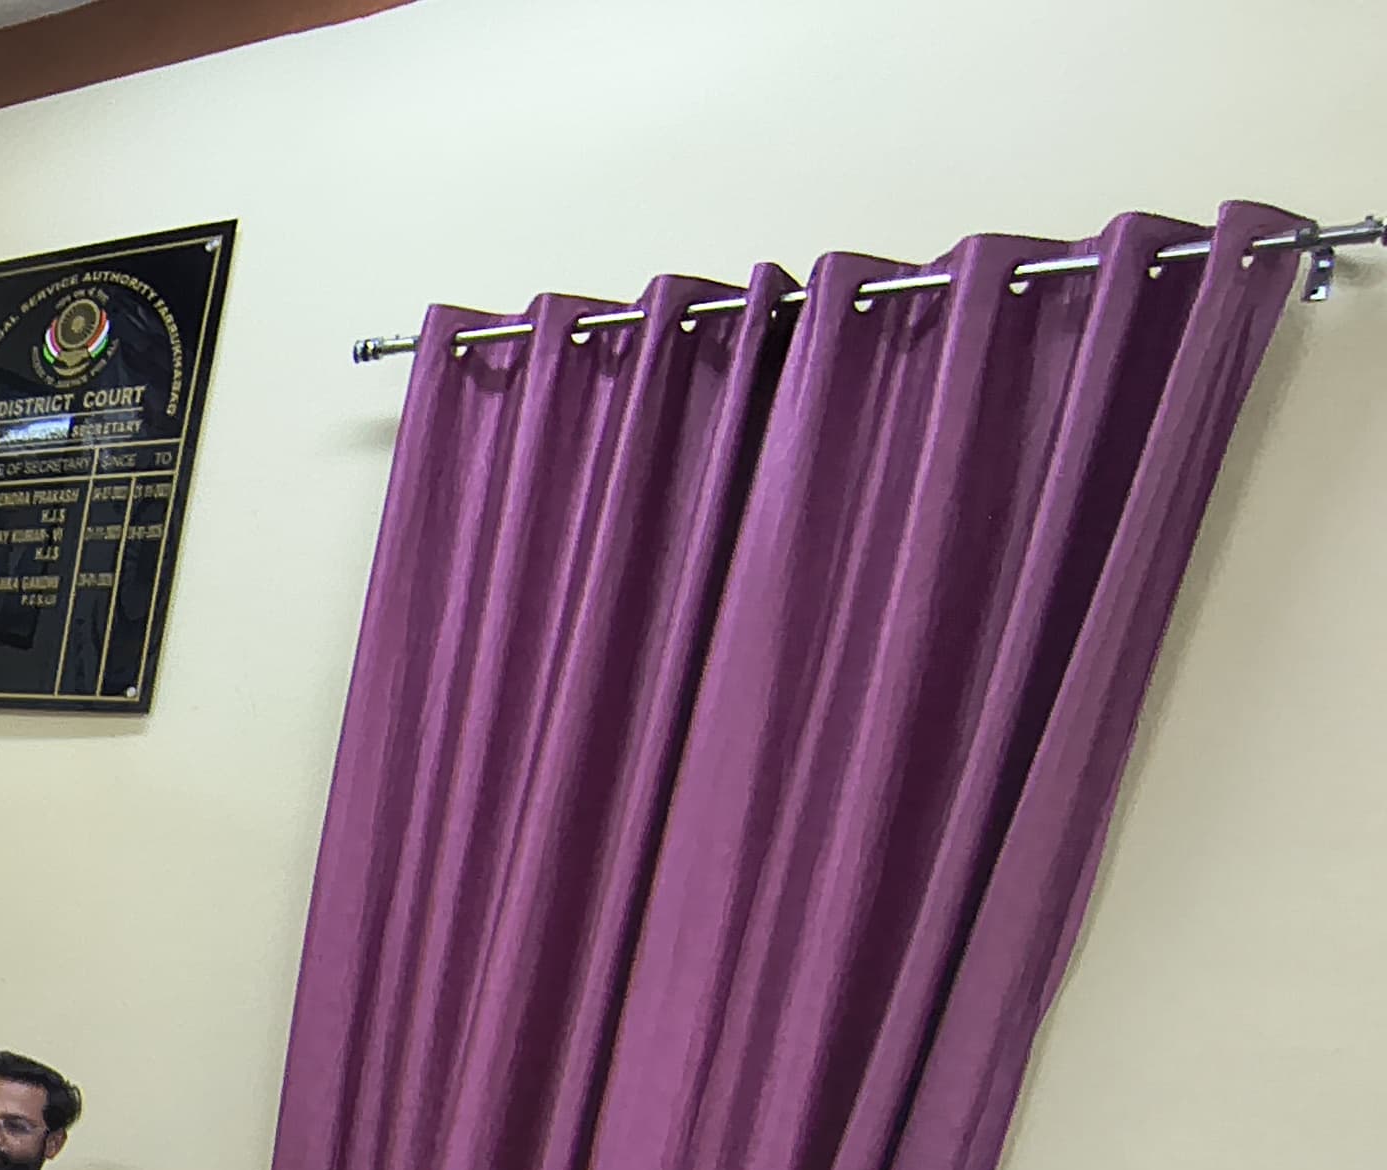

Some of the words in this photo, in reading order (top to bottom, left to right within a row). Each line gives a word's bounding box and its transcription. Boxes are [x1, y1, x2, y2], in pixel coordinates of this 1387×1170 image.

[83, 271, 158, 301] AUTHORITY
[83, 384, 147, 409] COURT
[72, 419, 143, 438] SECRETARY
[6, 462, 22, 475] OF
[24, 456, 92, 474] SECRETARY
[154, 452, 172, 465] TO
